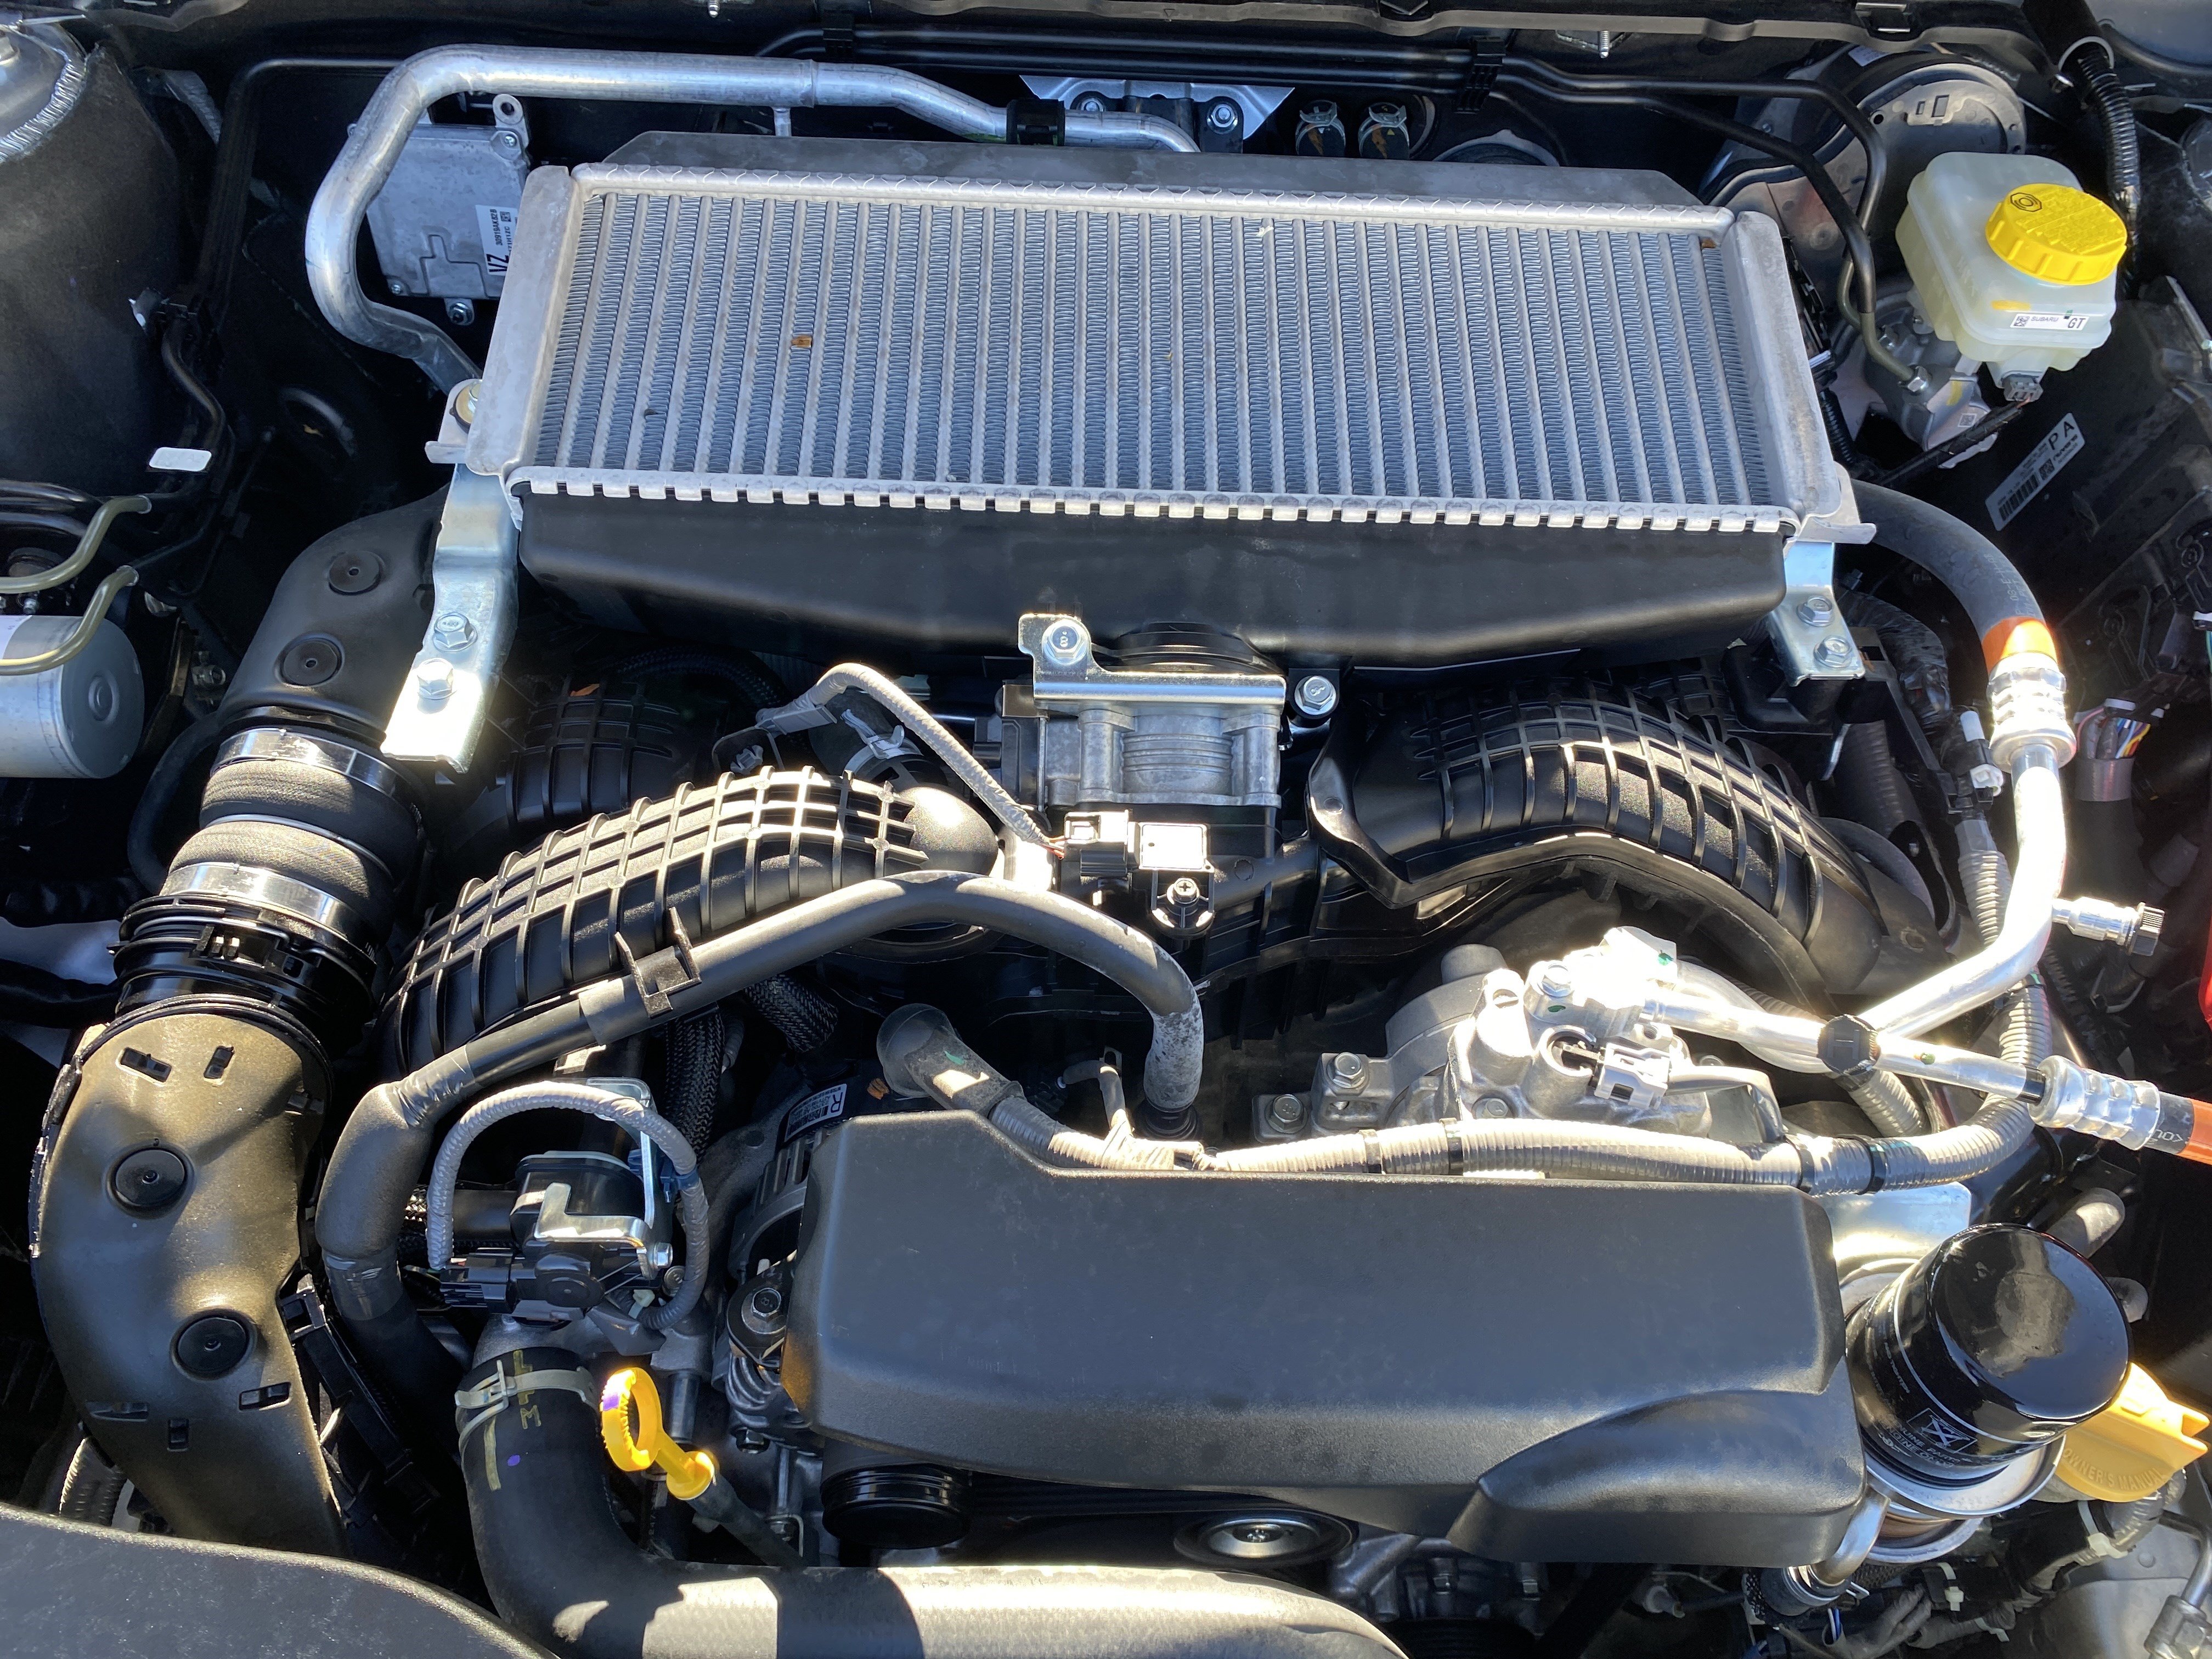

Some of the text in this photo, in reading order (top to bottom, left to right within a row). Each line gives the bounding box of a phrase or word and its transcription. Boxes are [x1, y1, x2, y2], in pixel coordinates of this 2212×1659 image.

[486, 253, 510, 272] VZ
[2068, 318, 2086, 329] GT
[831, 1092, 843, 1113] R
[2062, 1448, 2166, 1491] OWNER'S MANUAL
